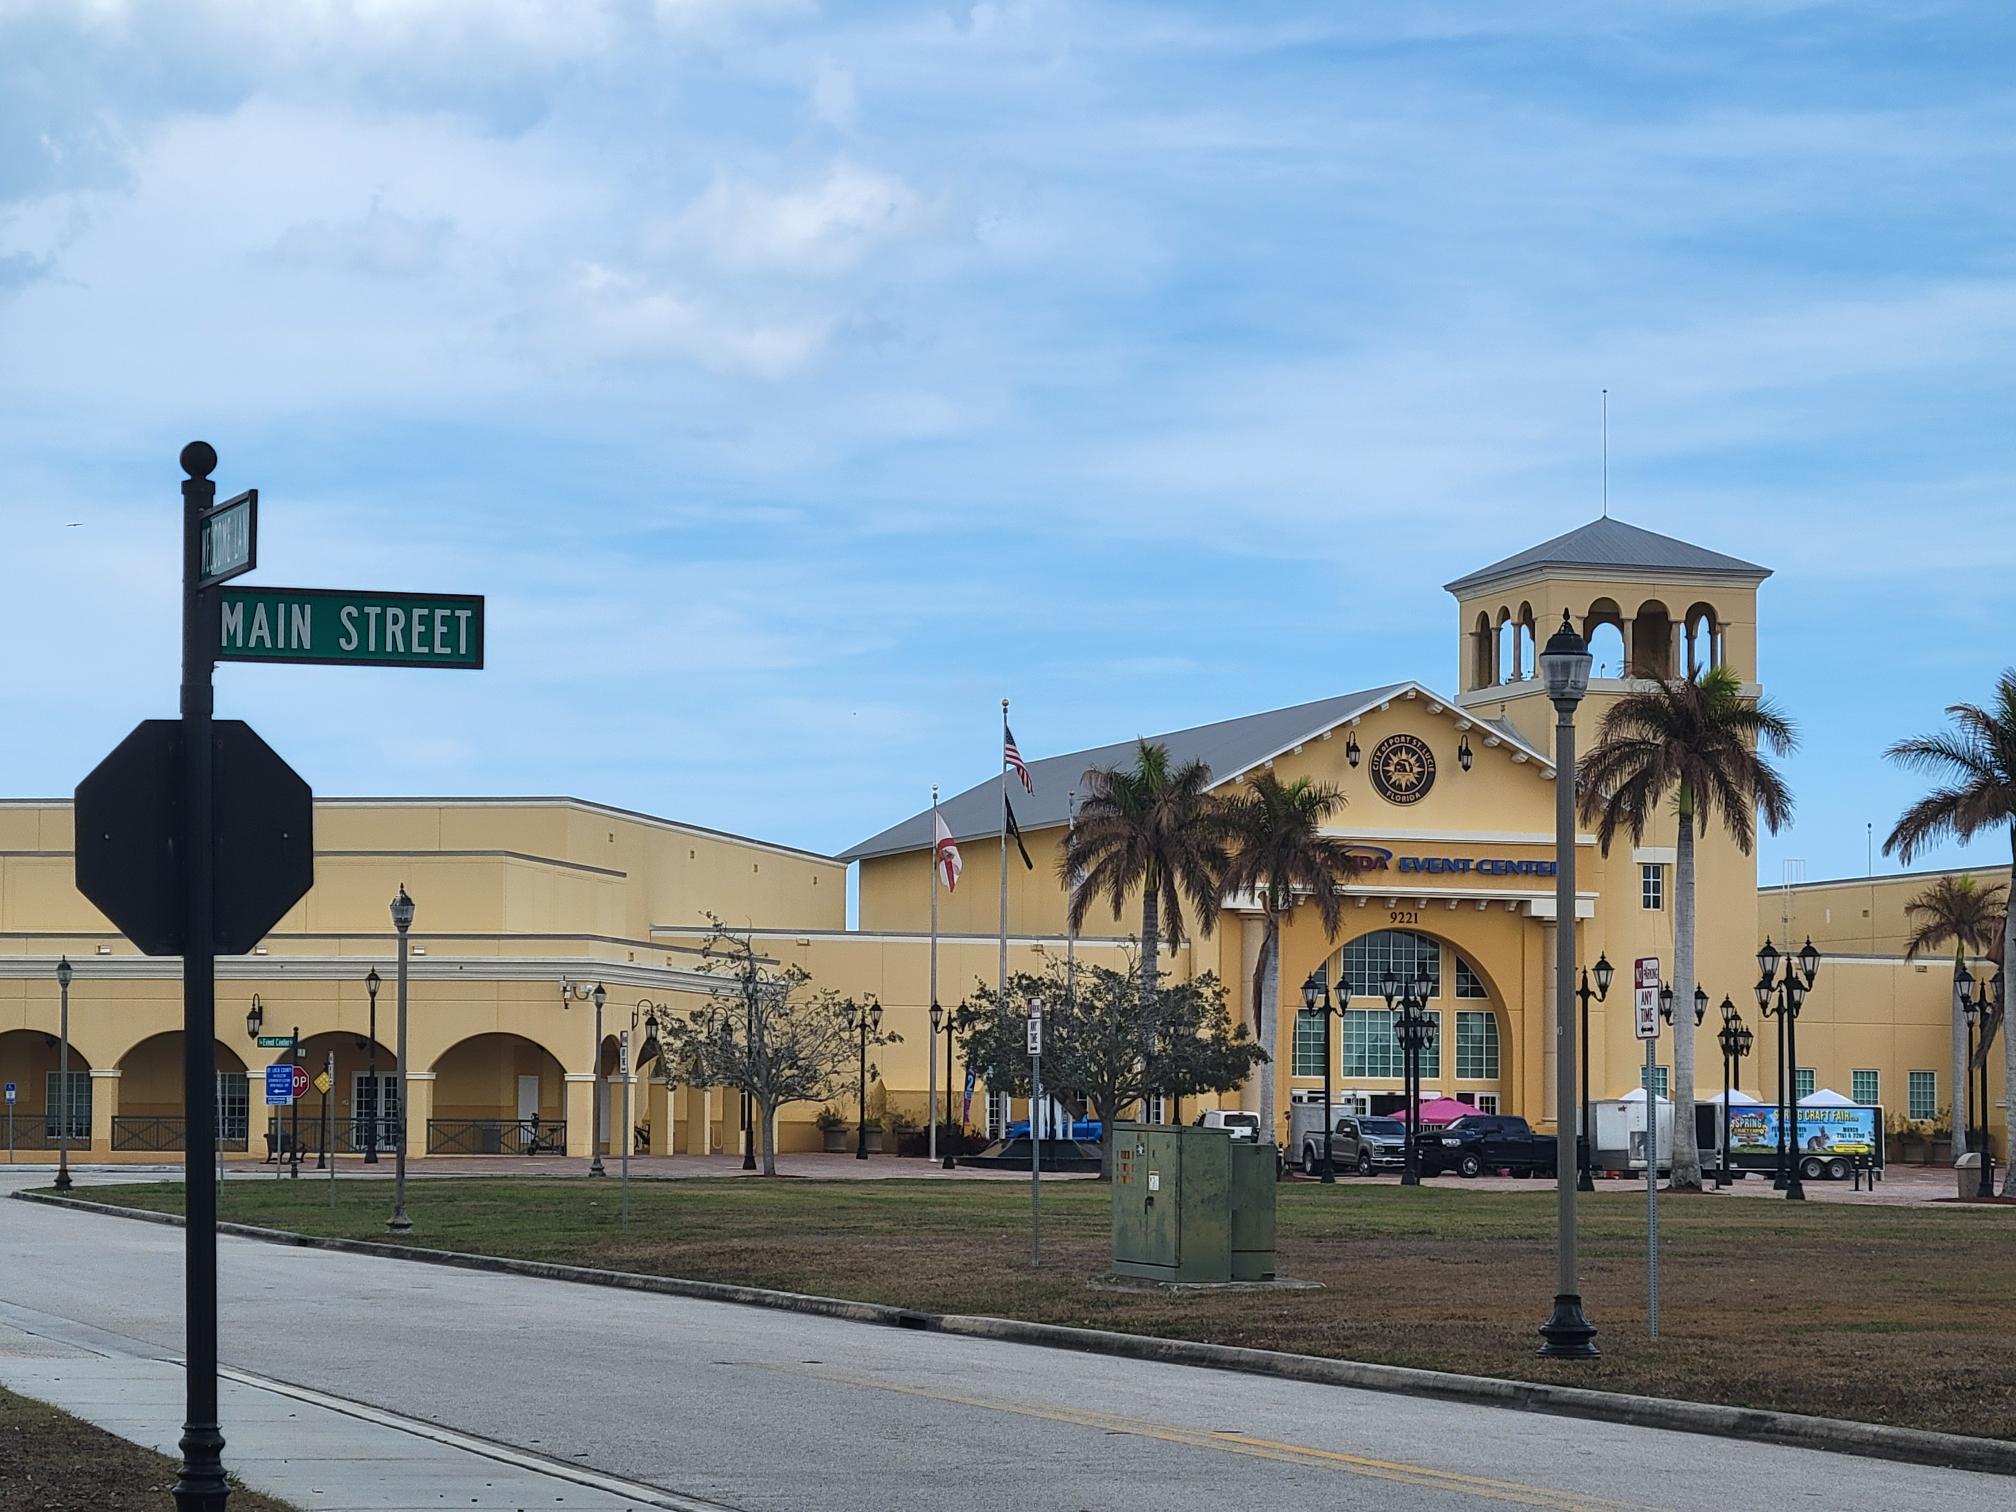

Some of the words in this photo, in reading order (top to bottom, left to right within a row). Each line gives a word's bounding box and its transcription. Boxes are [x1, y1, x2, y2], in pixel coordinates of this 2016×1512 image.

[234, 506, 249, 560] LAN
[221, 601, 311, 650] MAIN
[338, 605, 472, 654] STREET
[1373, 752, 1382, 770] CITY
[1381, 743, 1389, 752] of
[1389, 736, 1411, 745] PORT
[1412, 739, 1422, 750] ST.
[1422, 748, 1434, 771] LUCIE
[1386, 791, 1421, 802] FLORIDA
[1399, 856, 1475, 874] EVENT
[1390, 911, 1419, 924] 9221
[1641, 991, 1653, 1005] ANY
[1640, 1008, 1653, 1022] TIME
[293, 1076, 306, 1087] OP
[1804, 1110, 1830, 1121] CRAFT
[1832, 1110, 1850, 1121] FAIR
[1736, 1118, 1761, 1128] SPRING
